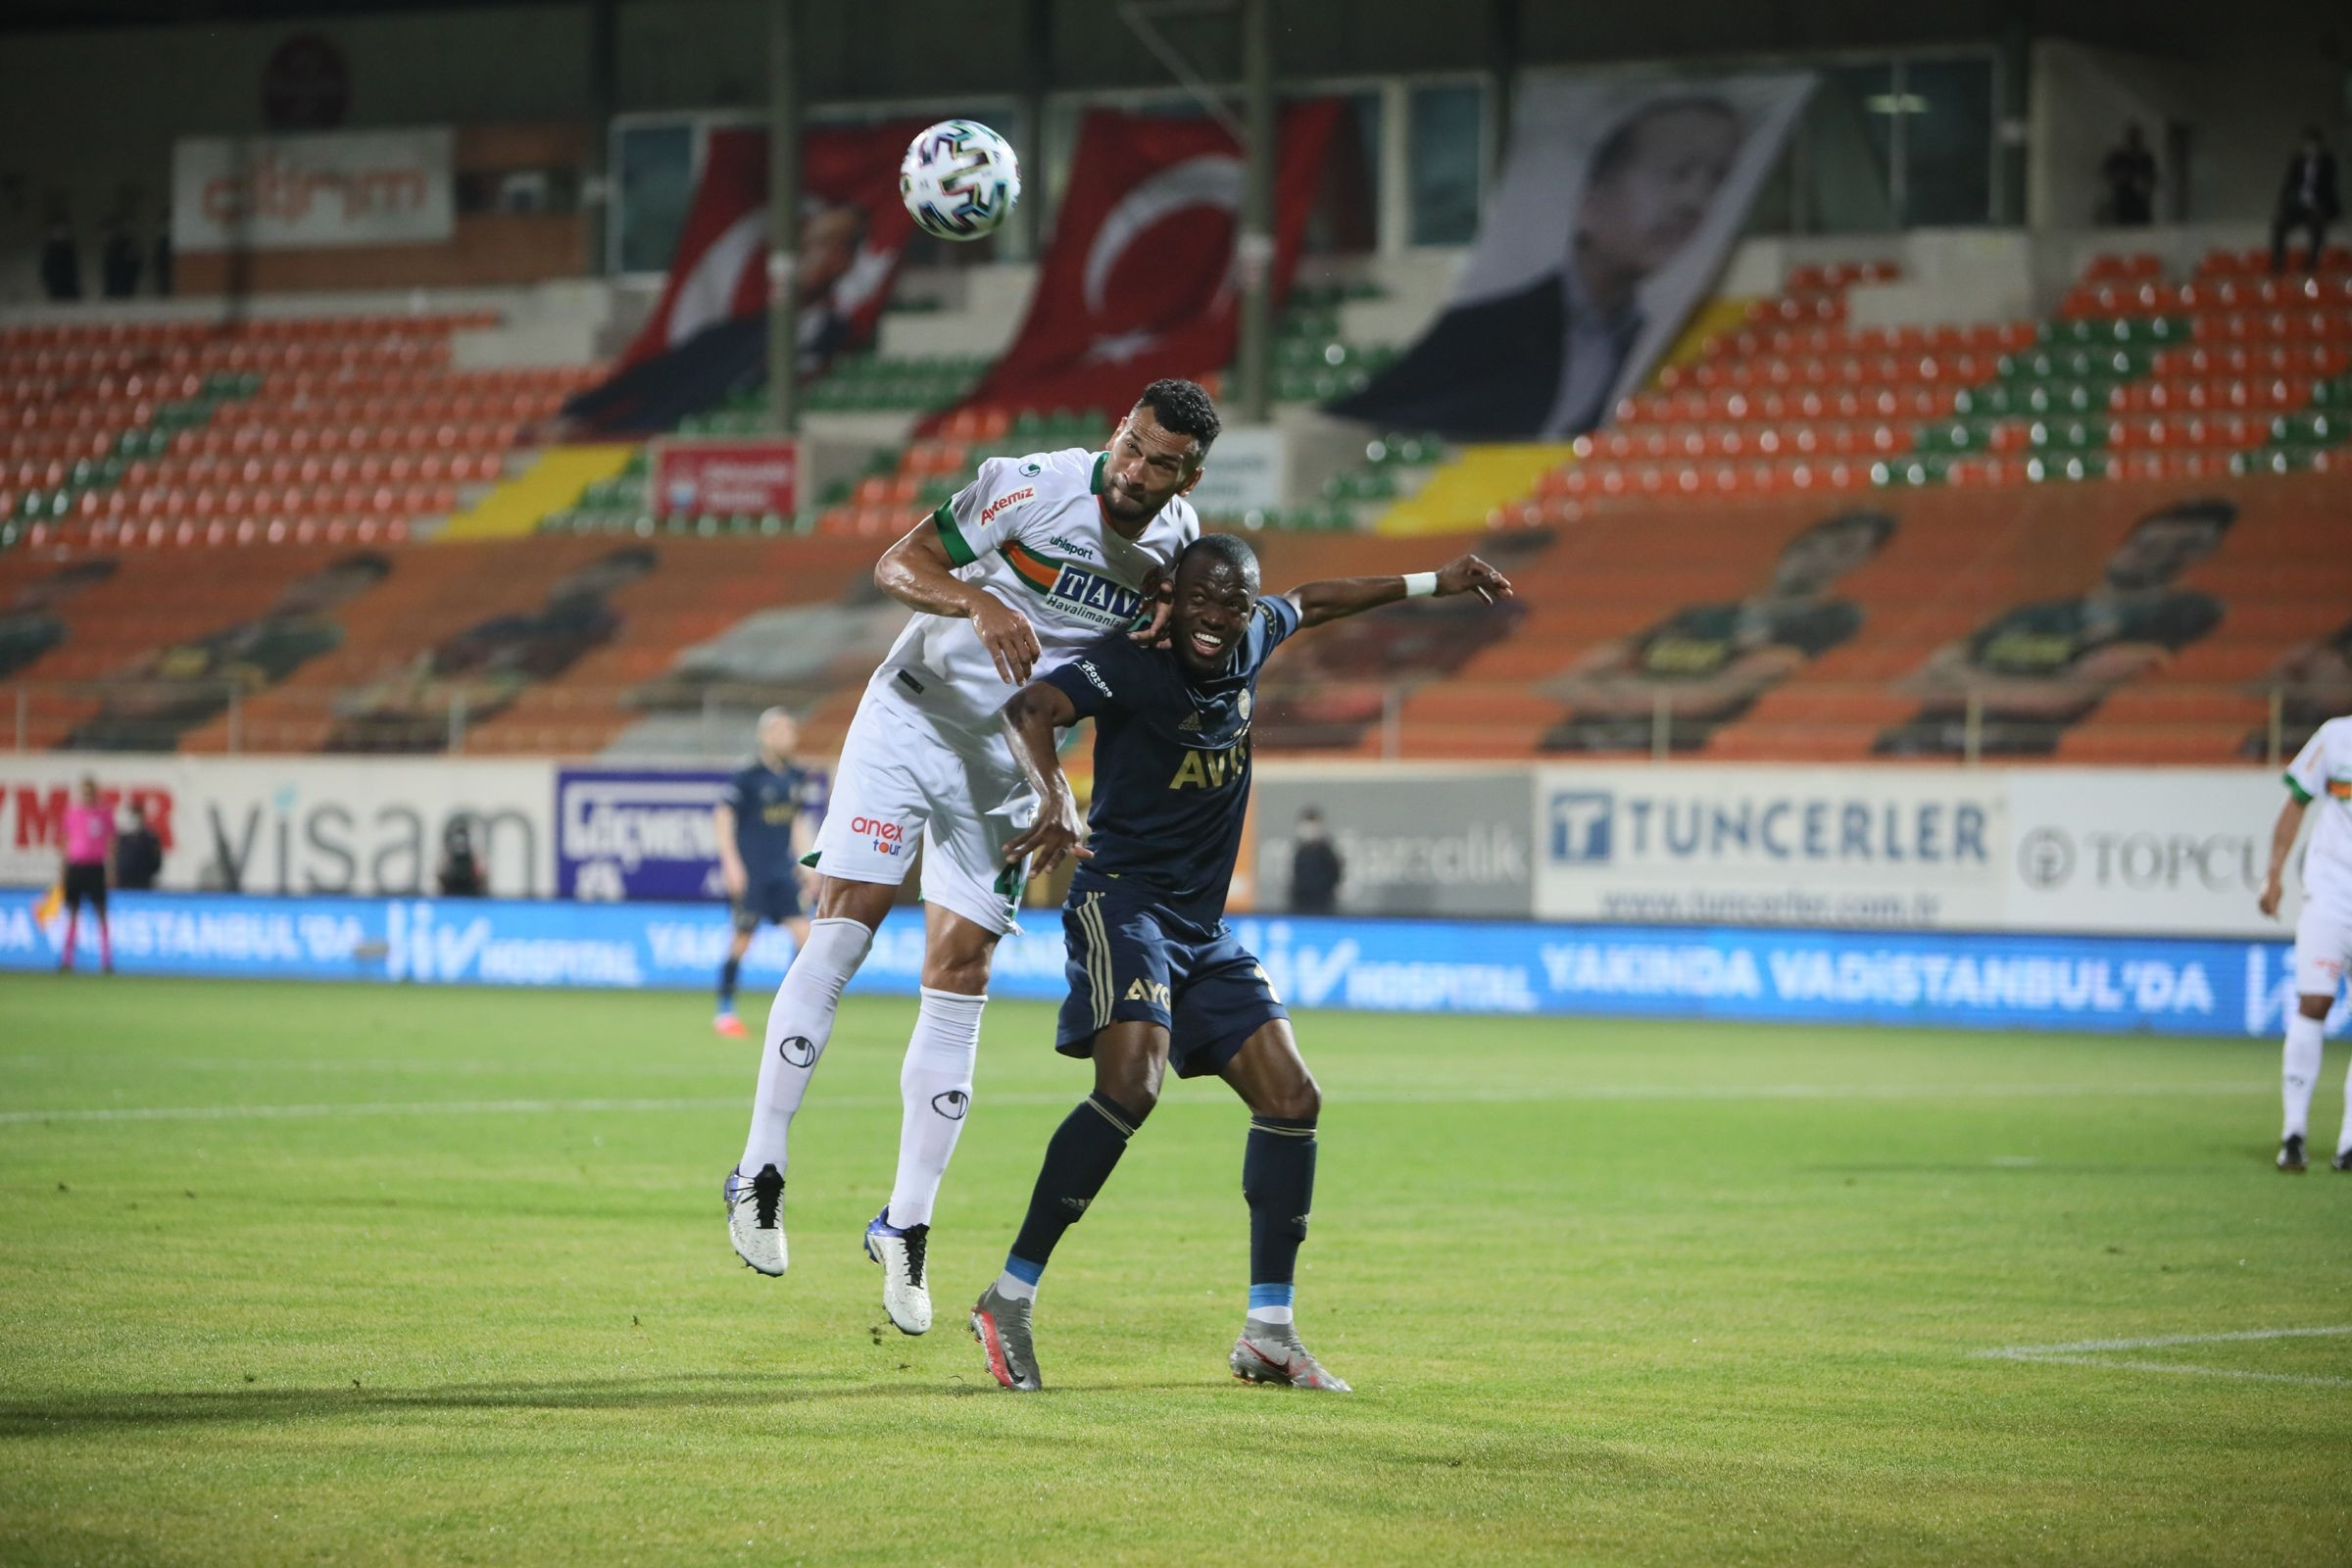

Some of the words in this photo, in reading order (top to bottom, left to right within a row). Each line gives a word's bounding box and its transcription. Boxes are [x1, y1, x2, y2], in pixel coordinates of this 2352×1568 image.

[980, 487, 1035, 526] Aytemiz
[1050, 535, 1094, 561] uhlsport
[1065, 572, 1137, 613] TAV
[851, 815, 904, 842] anex
[873, 838, 902, 858] tour
[1627, 800, 1989, 860] TUNCERLER
[2084, 829, 2307, 895] TOPCU
